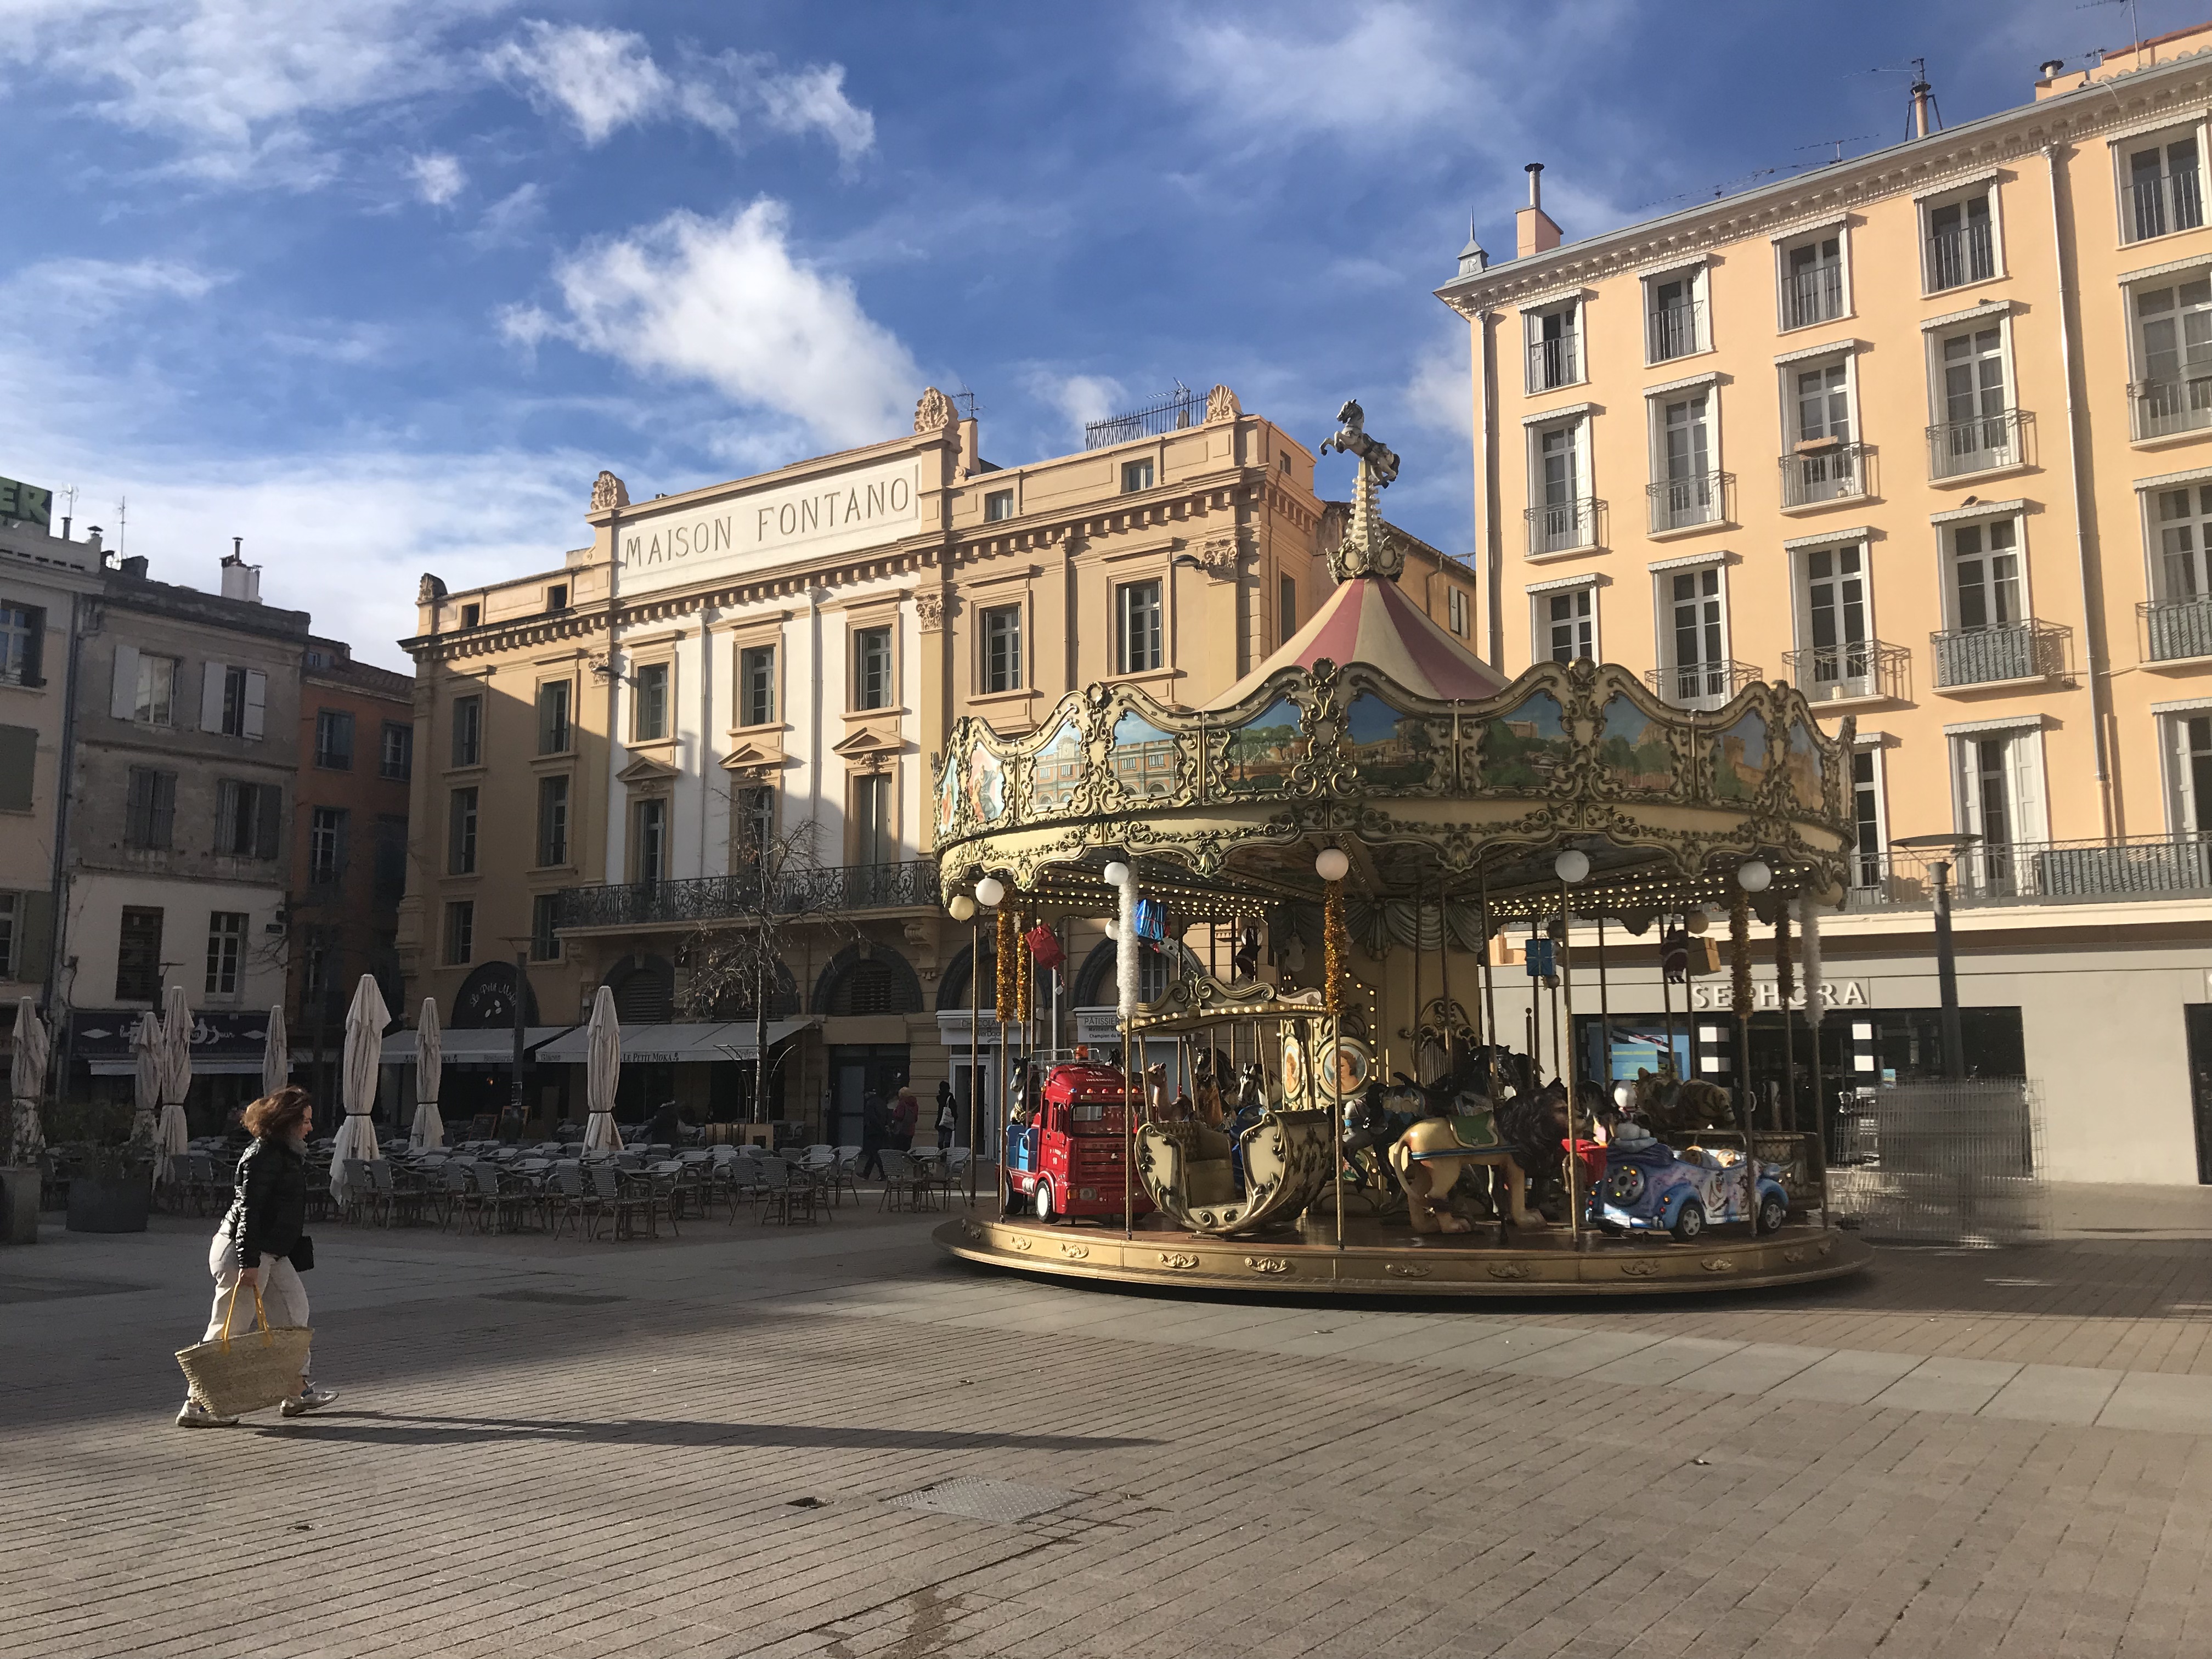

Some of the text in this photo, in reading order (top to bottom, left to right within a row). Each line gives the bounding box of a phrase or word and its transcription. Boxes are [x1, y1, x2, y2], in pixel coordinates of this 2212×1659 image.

[624, 477, 909, 570] MAISON FONTANO
[1692, 981, 1866, 1007] SEHORA
[624, 1053, 631, 1062] LE
